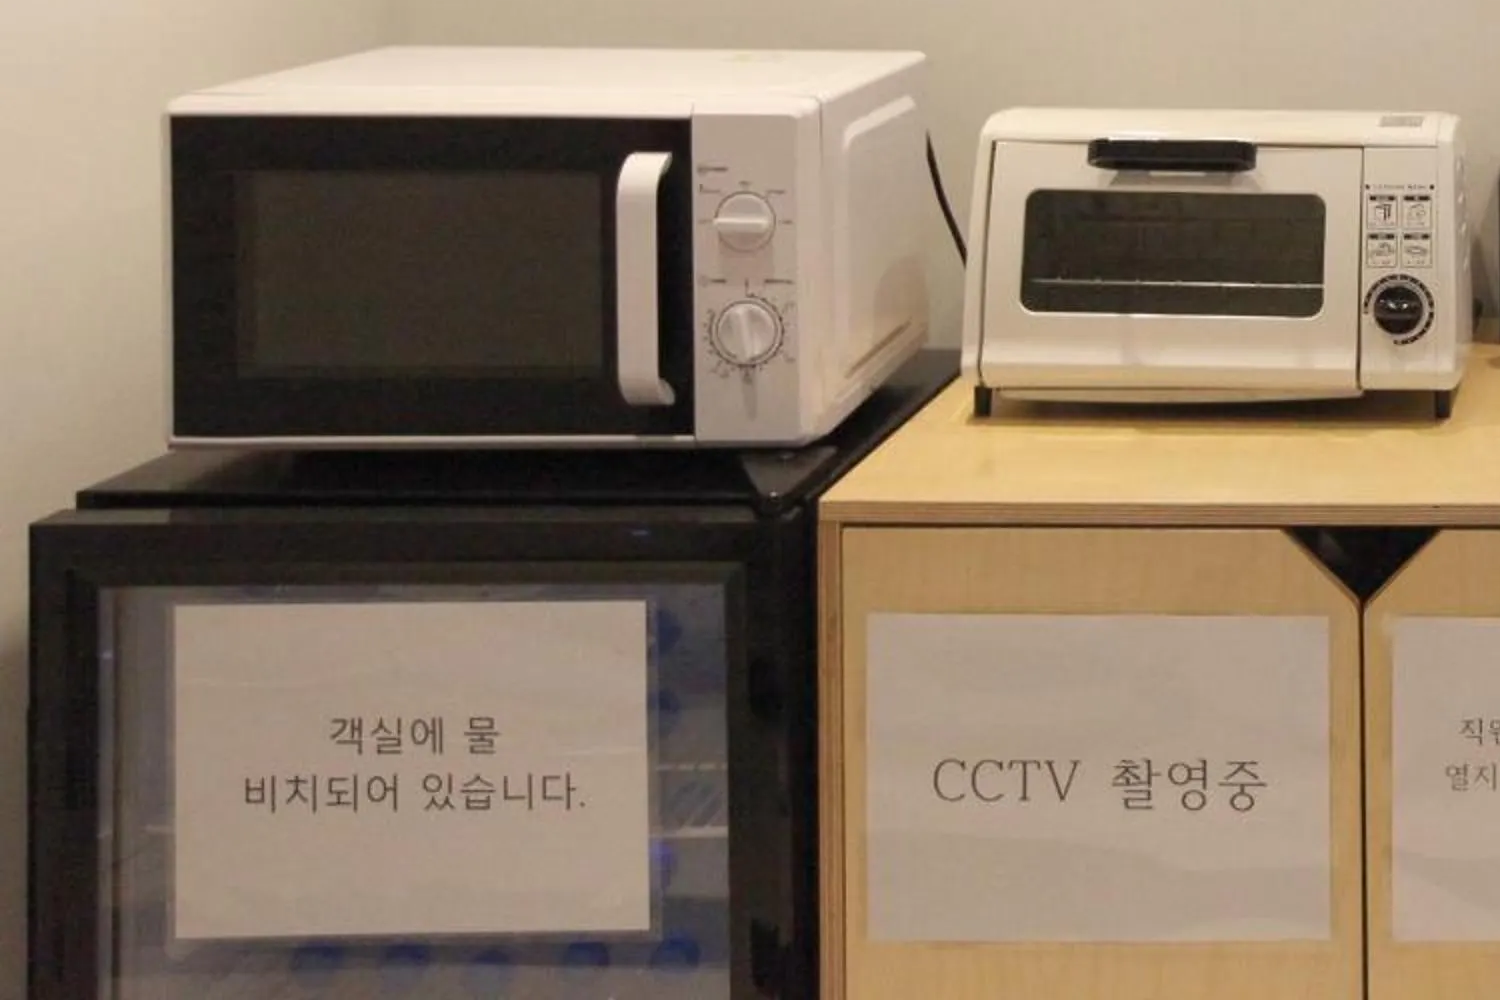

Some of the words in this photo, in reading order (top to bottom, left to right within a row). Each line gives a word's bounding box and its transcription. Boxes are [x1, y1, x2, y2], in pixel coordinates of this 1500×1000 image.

[328, 715, 445, 757] 객실에
[462, 715, 501, 756] 물
[243, 772, 399, 815] 비치되어
[420, 771, 587, 812] 있습니다.
[932, 757, 1082, 803] CCTV
[1111, 757, 1268, 814] 촬영중
